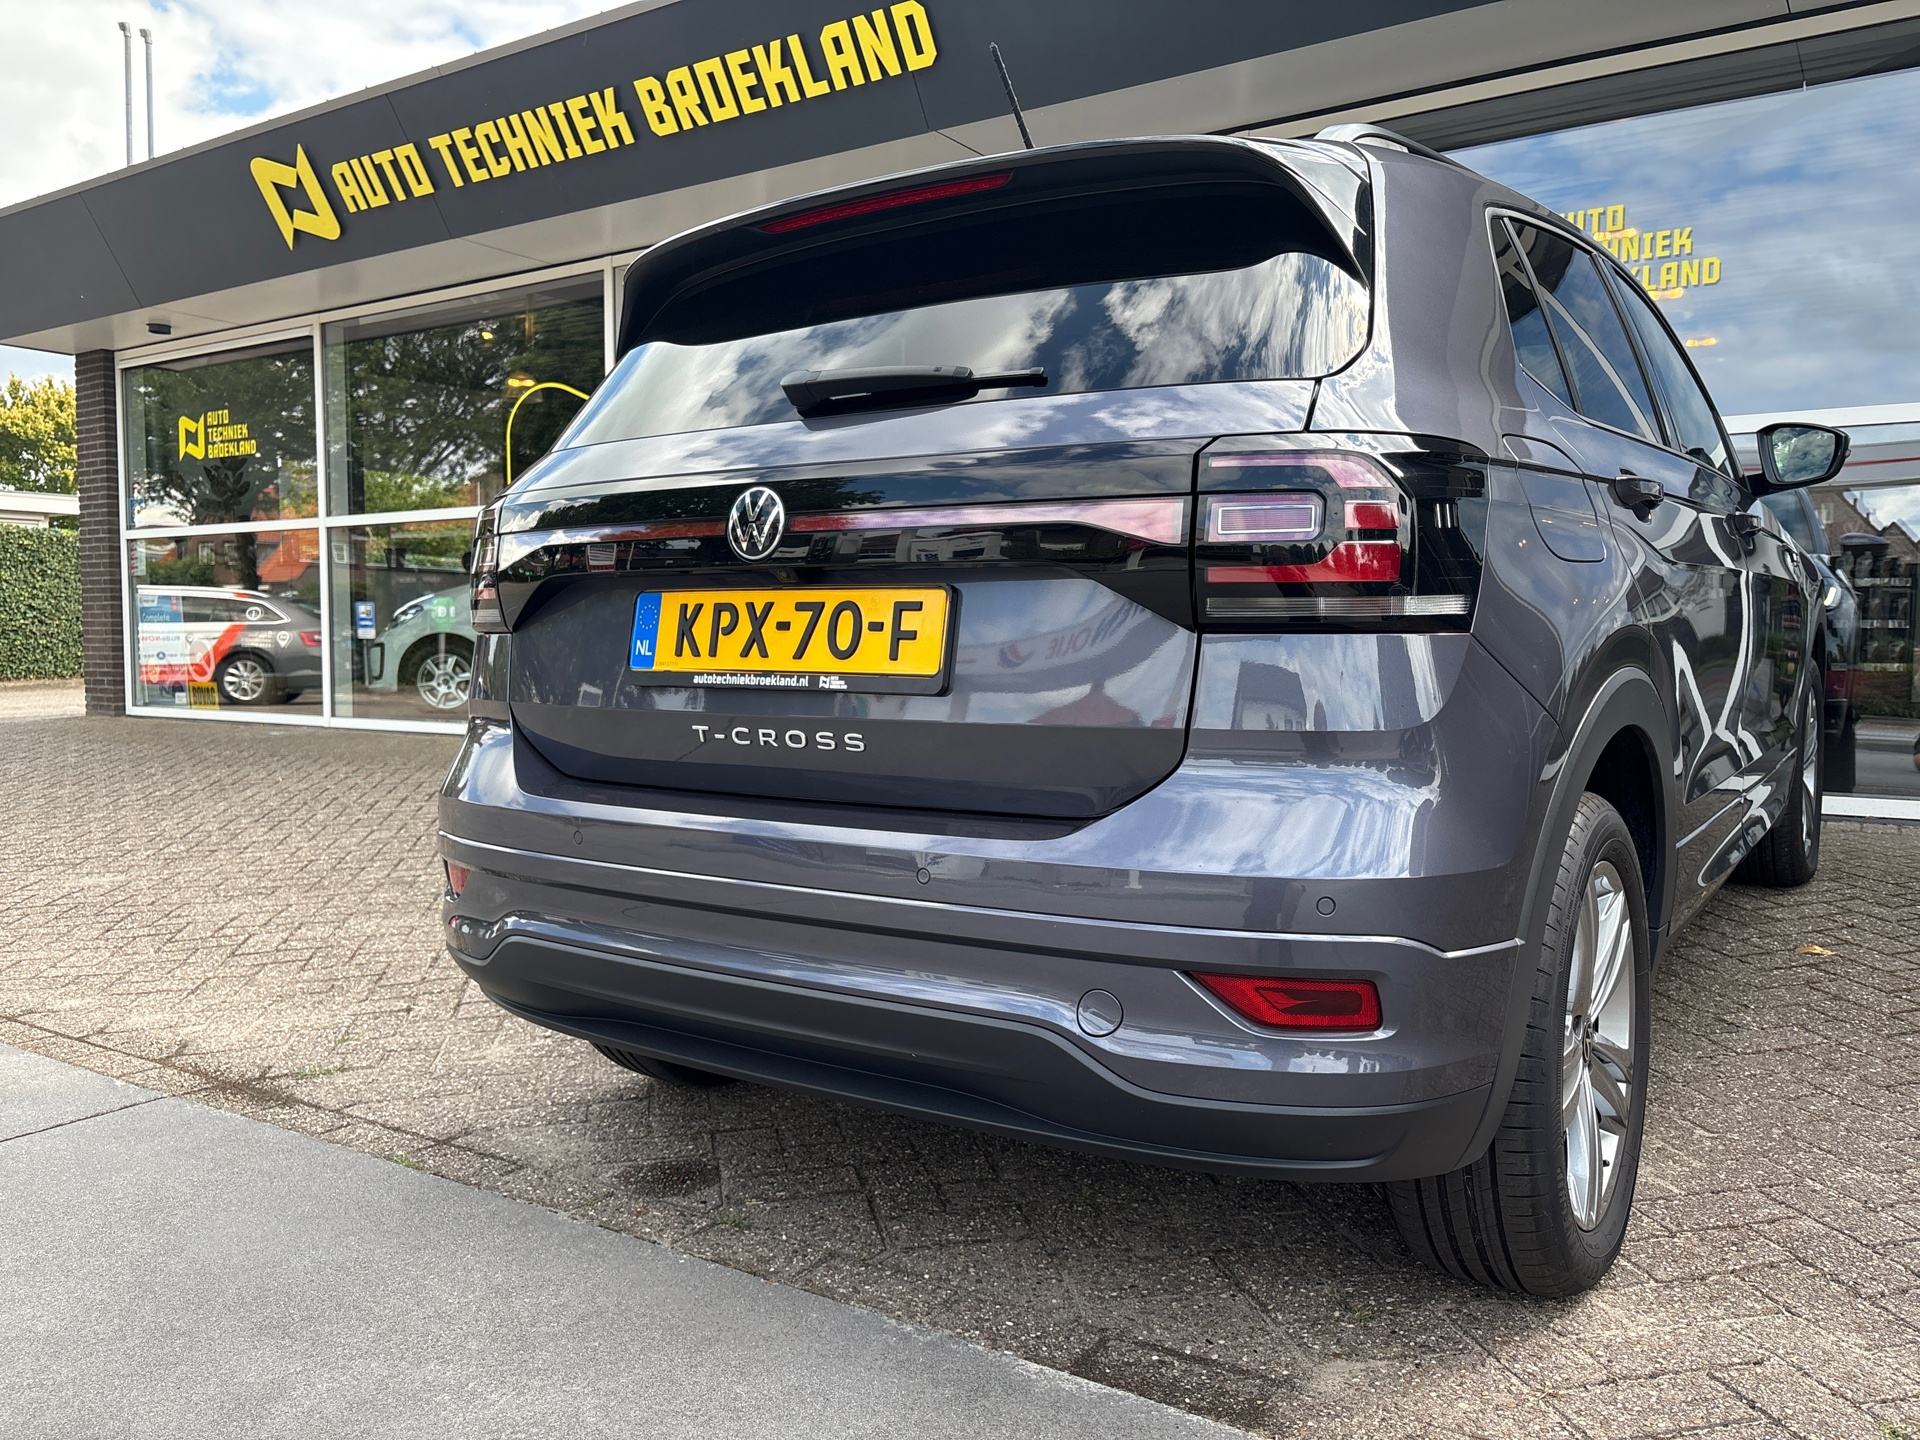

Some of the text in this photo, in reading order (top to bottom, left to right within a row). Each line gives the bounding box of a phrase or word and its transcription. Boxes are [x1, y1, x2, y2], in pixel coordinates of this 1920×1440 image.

[331, 0, 938, 213] AUTO TECHNIEK BROEKLAND
[1559, 204, 1625, 234] UTO
[1602, 227, 1693, 263] HNIEK
[207, 409, 229, 426] AUTO
[207, 423, 248, 443] TECHNIEK
[208, 439, 257, 459] BROEKLAND
[142, 613, 170, 623] Complete
[674, 600, 924, 661] KPX-70-F
[635, 639, 653, 656] NL
[693, 673, 809, 687] autotechniekbroekland.nl
[691, 725, 866, 752] T-CROSS
